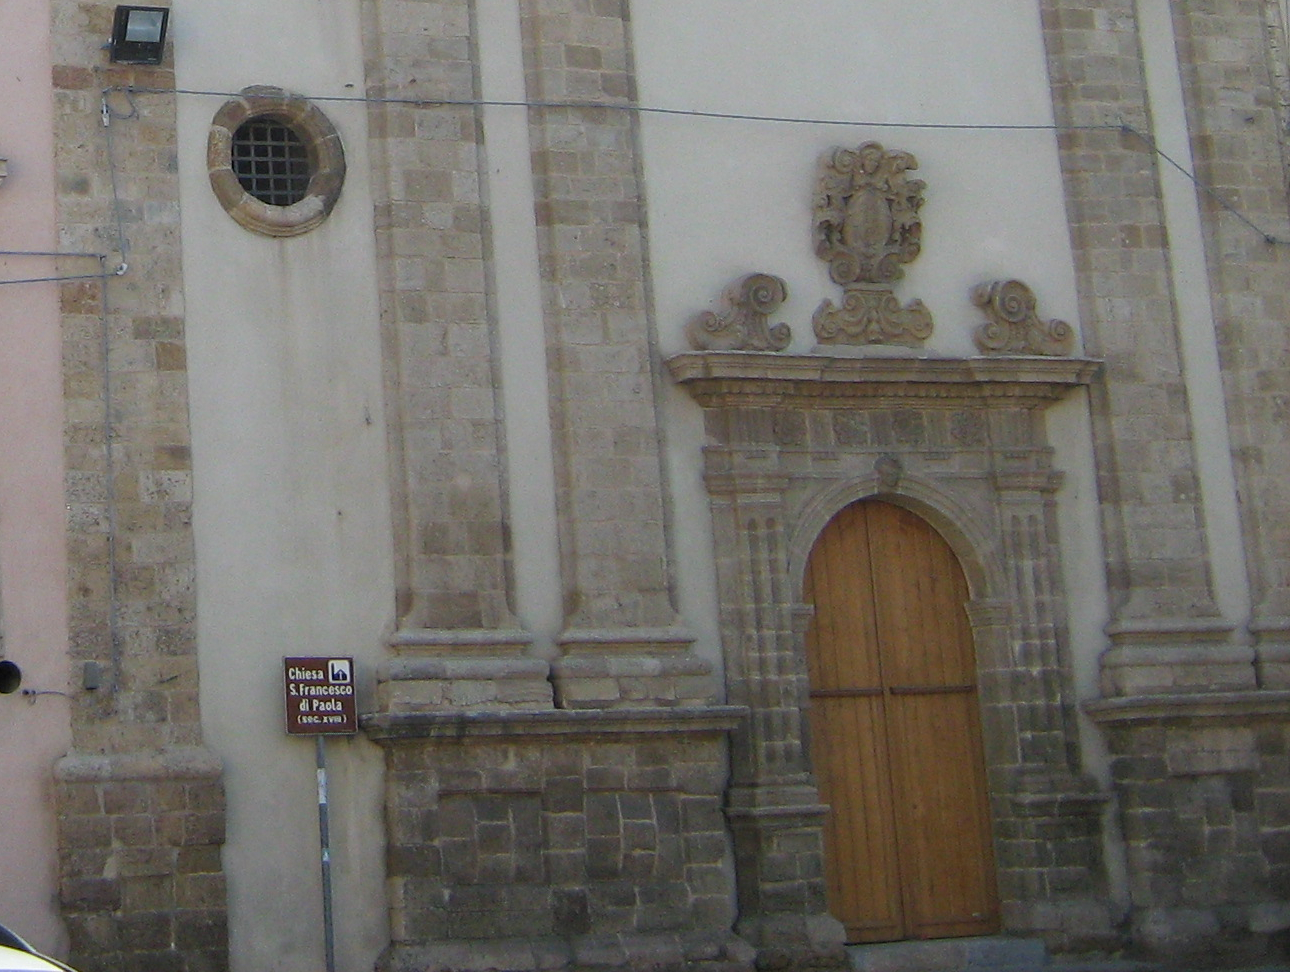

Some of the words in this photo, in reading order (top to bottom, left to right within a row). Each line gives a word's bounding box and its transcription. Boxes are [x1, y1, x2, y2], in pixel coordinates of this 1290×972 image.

[288, 667, 325, 680] Chiesa
[299, 698, 310, 712] di
[312, 698, 343, 712] Paola
